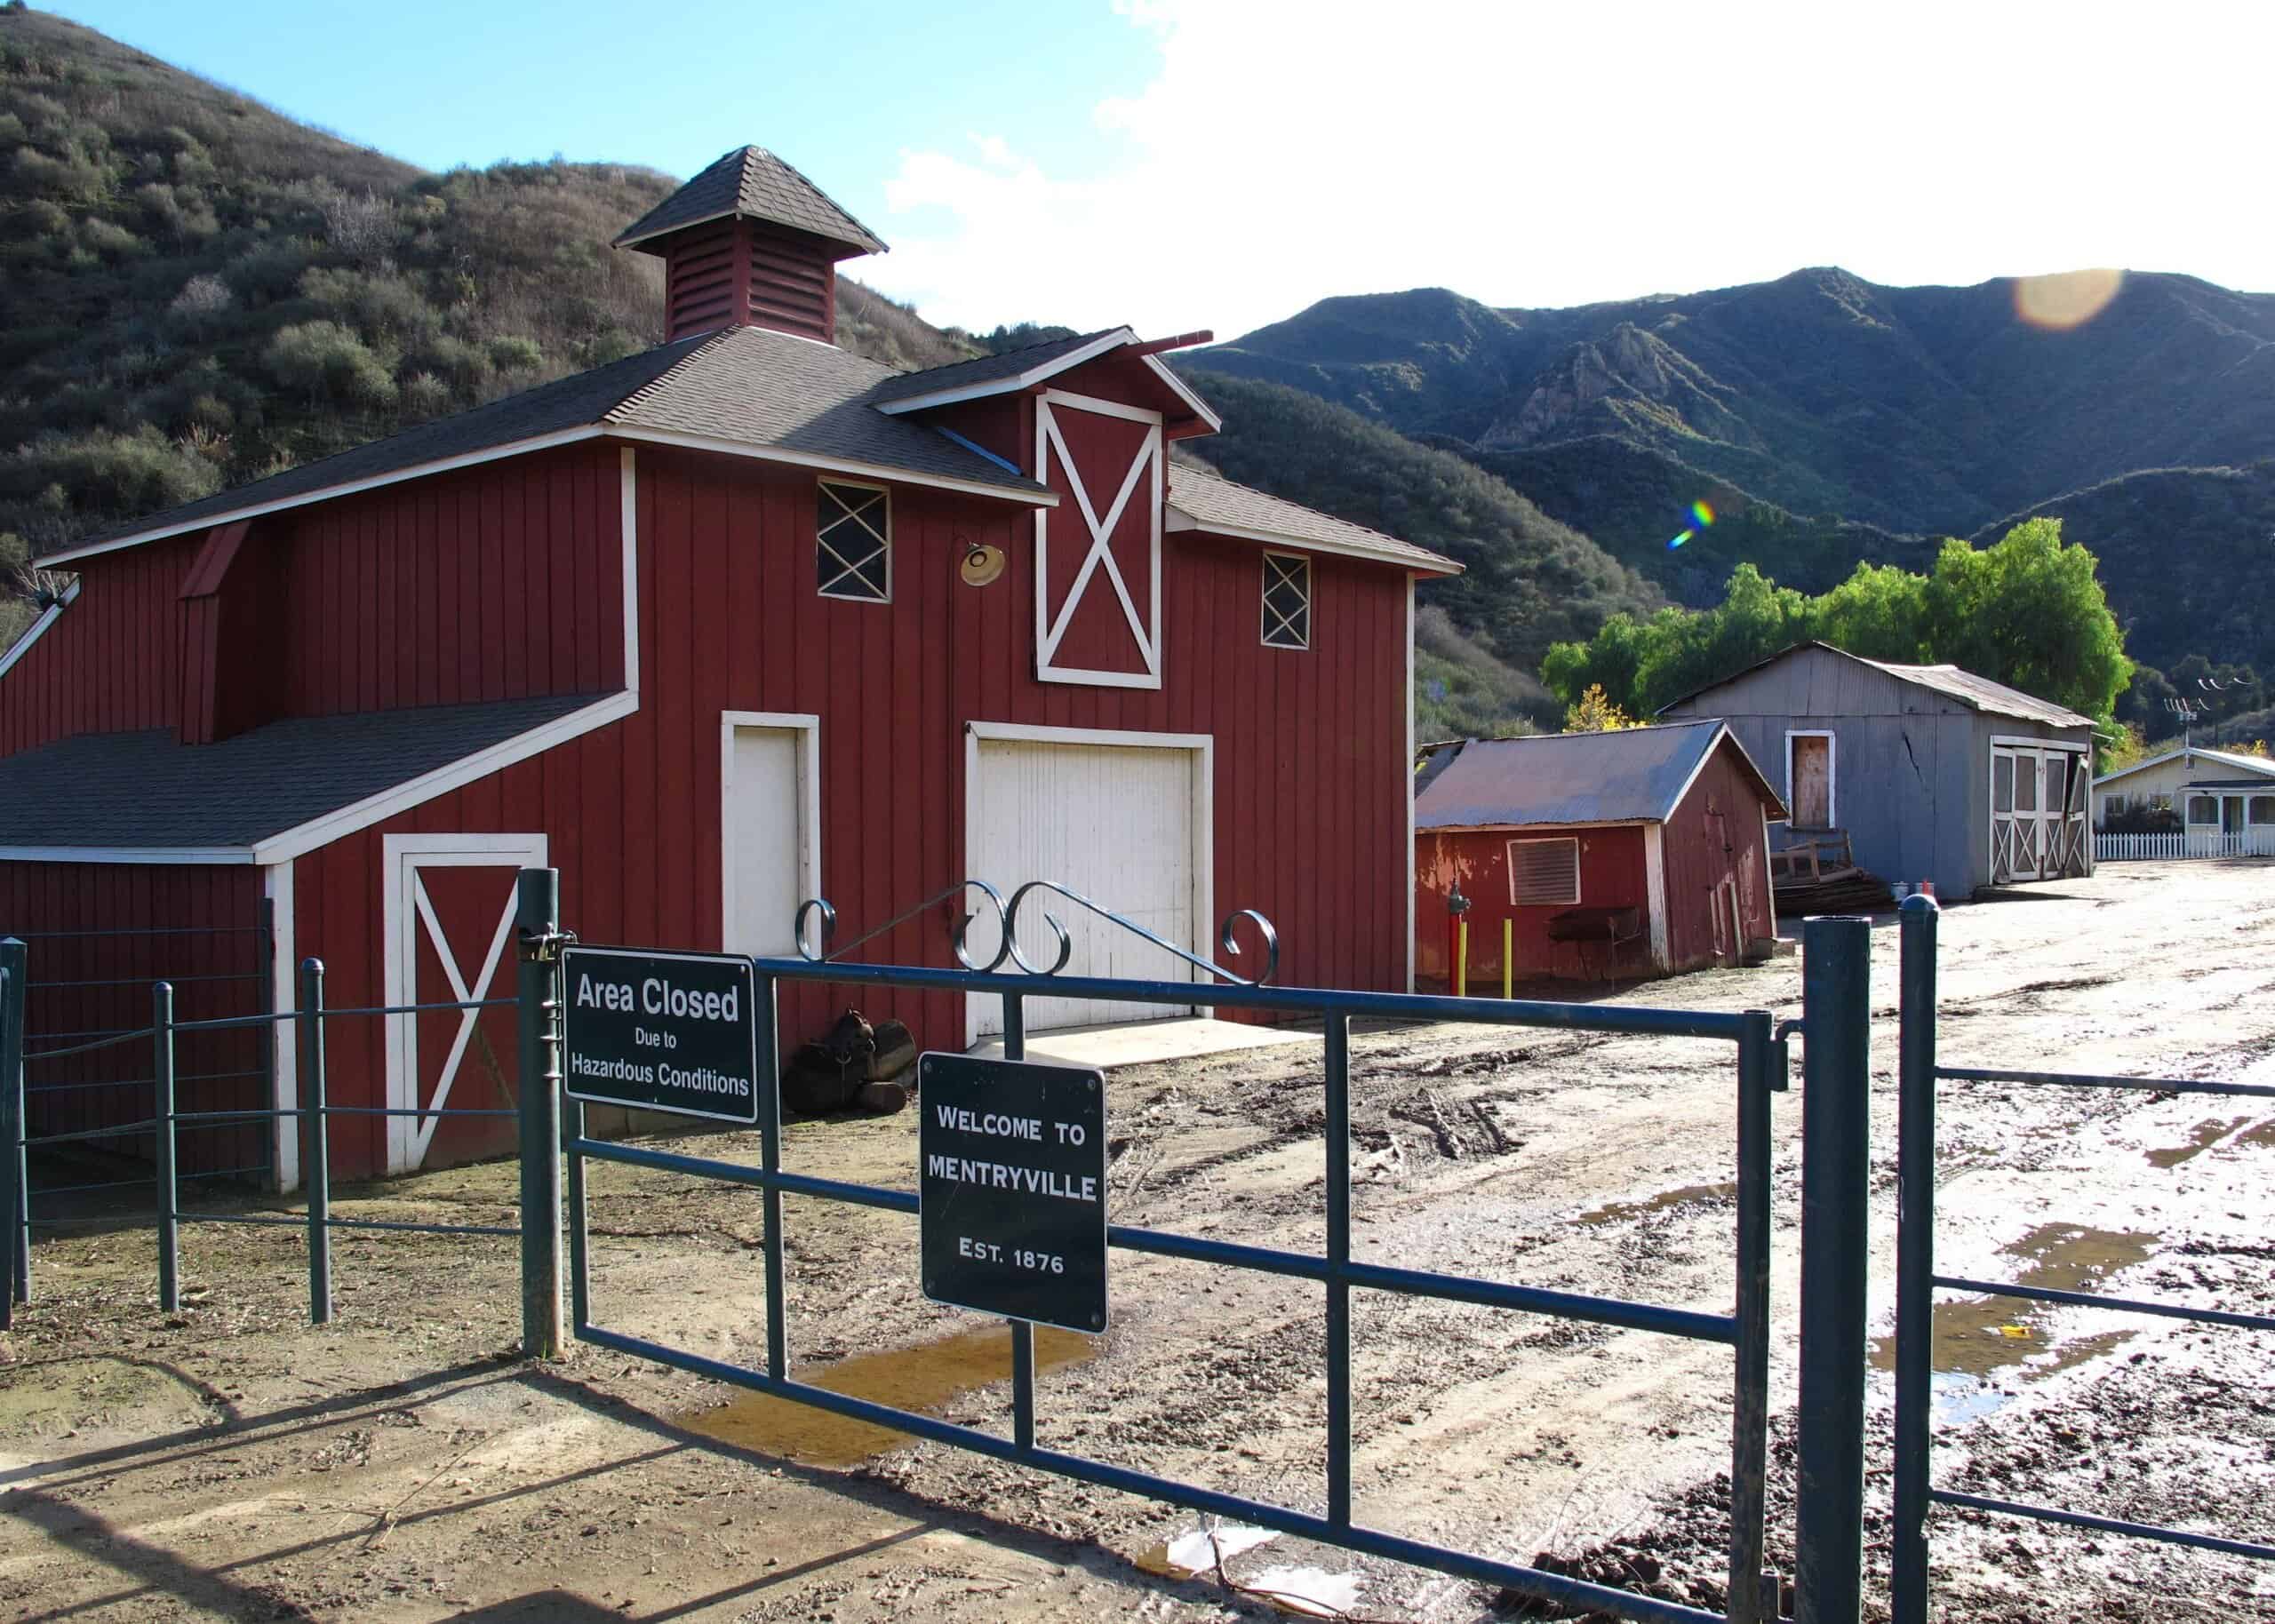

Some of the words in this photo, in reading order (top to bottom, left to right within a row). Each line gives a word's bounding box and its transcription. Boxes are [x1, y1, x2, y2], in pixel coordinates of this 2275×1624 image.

[577, 973, 635, 1012] Area
[643, 977, 738, 1022] Closed
[635, 1027, 661, 1047] Due
[664, 1031, 677, 1049] to
[571, 1051, 653, 1084] Hazardous
[658, 1063, 749, 1096] Conditions
[937, 1104, 1042, 1142] WELCOME
[1054, 1122, 1085, 1146] TO
[929, 1154, 1097, 1202] MENTRYVILLE
[959, 1236, 1003, 1263] EST.
[1014, 1249, 1064, 1274] 1876
